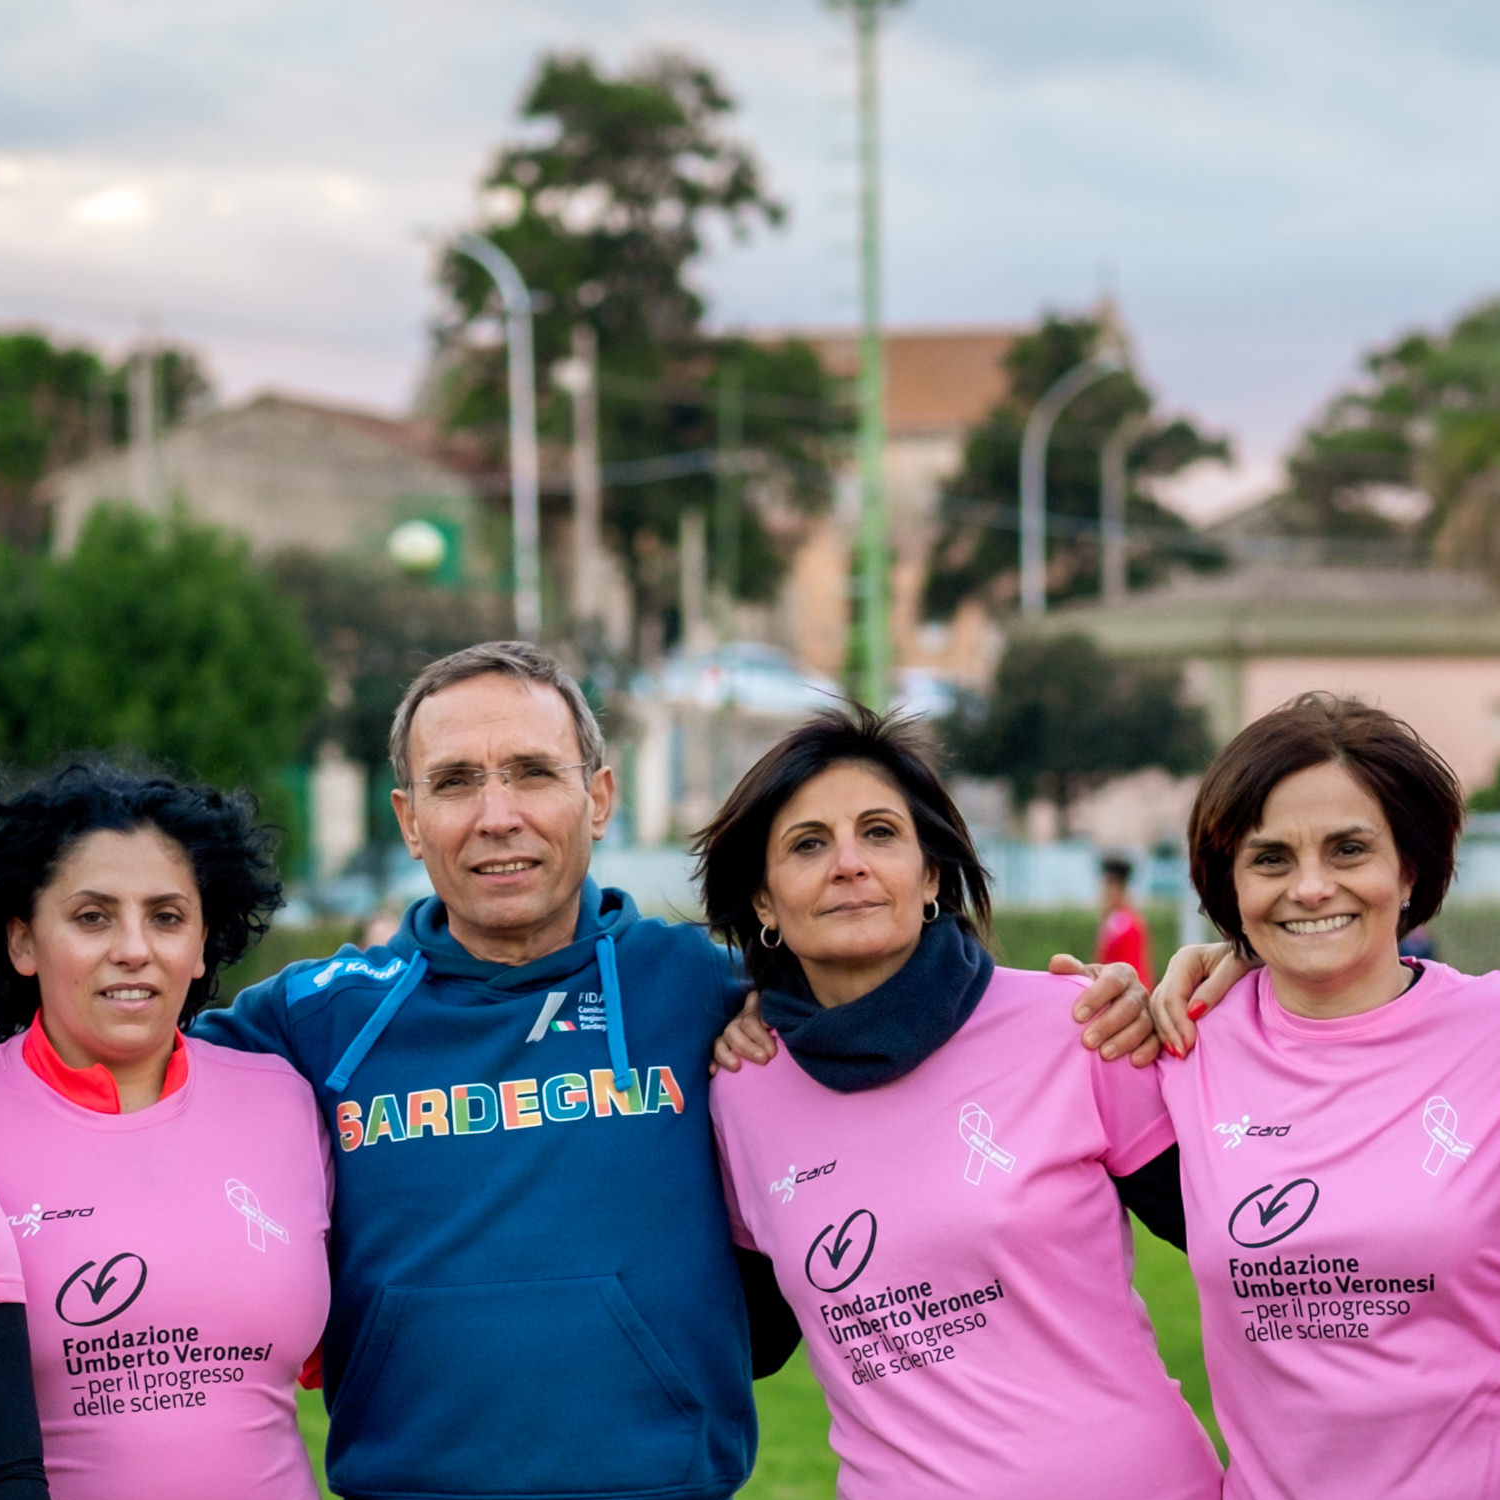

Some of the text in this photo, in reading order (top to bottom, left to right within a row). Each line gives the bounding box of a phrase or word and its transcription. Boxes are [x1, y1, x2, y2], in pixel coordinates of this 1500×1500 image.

[336, 1066, 684, 1152] SARDEGNA
[1229, 1254, 1359, 1278] Fondazione
[1233, 1273, 1435, 1299] Umberto Veronesi
[820, 1280, 933, 1325] Fondazione
[828, 1279, 1005, 1345] Umberto Veronesi
[1293, 1298, 1304, 1319] il
[1308, 1298, 1411, 1321] progresso
[62, 1326, 199, 1358] Fondazione
[882, 1332, 894, 1352] il
[895, 1312, 987, 1354] progresso
[1245, 1319, 1369, 1343] delle scienze
[65, 1343, 273, 1376] Umberto Veronesi
[851, 1344, 955, 1386] delle scienze
[128, 1371, 139, 1391] il
[144, 1367, 245, 1394] progresso
[73, 1390, 207, 1417] delle scienze
